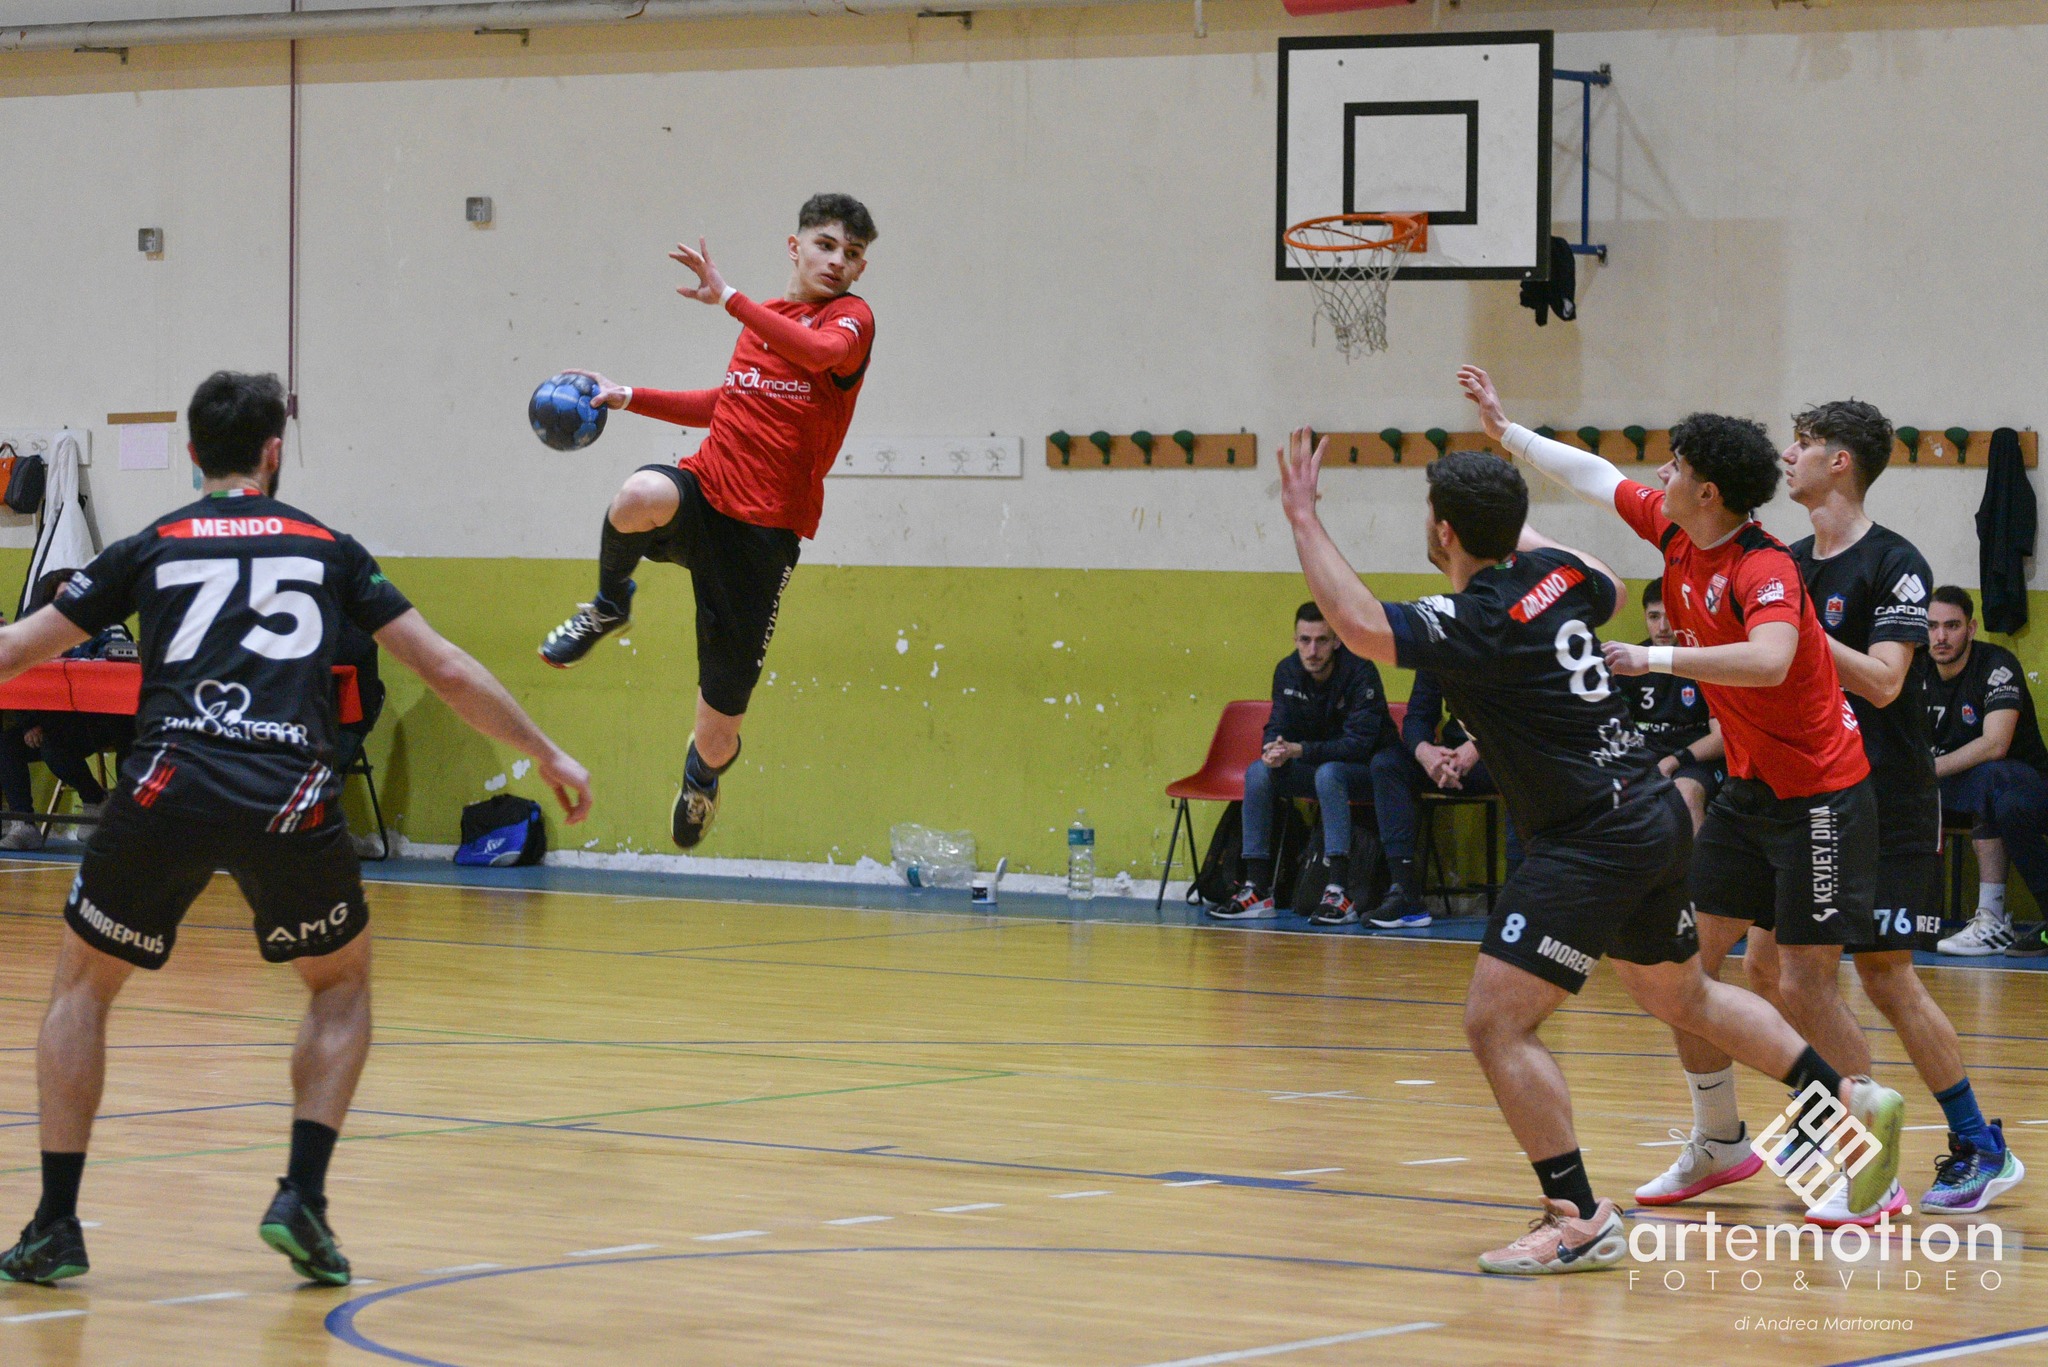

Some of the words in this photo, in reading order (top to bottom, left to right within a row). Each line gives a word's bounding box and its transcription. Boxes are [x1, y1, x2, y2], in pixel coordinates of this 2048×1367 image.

[192, 518, 283, 537] MENDO
[156, 556, 324, 663] 75
[1555, 619, 1611, 702] 8
[1640, 686, 1655, 710] 3
[1809, 805, 1831, 840] DNM
[1812, 845, 1832, 903] KEYJEY
[78, 898, 164, 955] MOREPLUS
[266, 902, 349, 943] AMG
[1501, 912, 1527, 943] 8
[1873, 907, 1912, 936] 76
